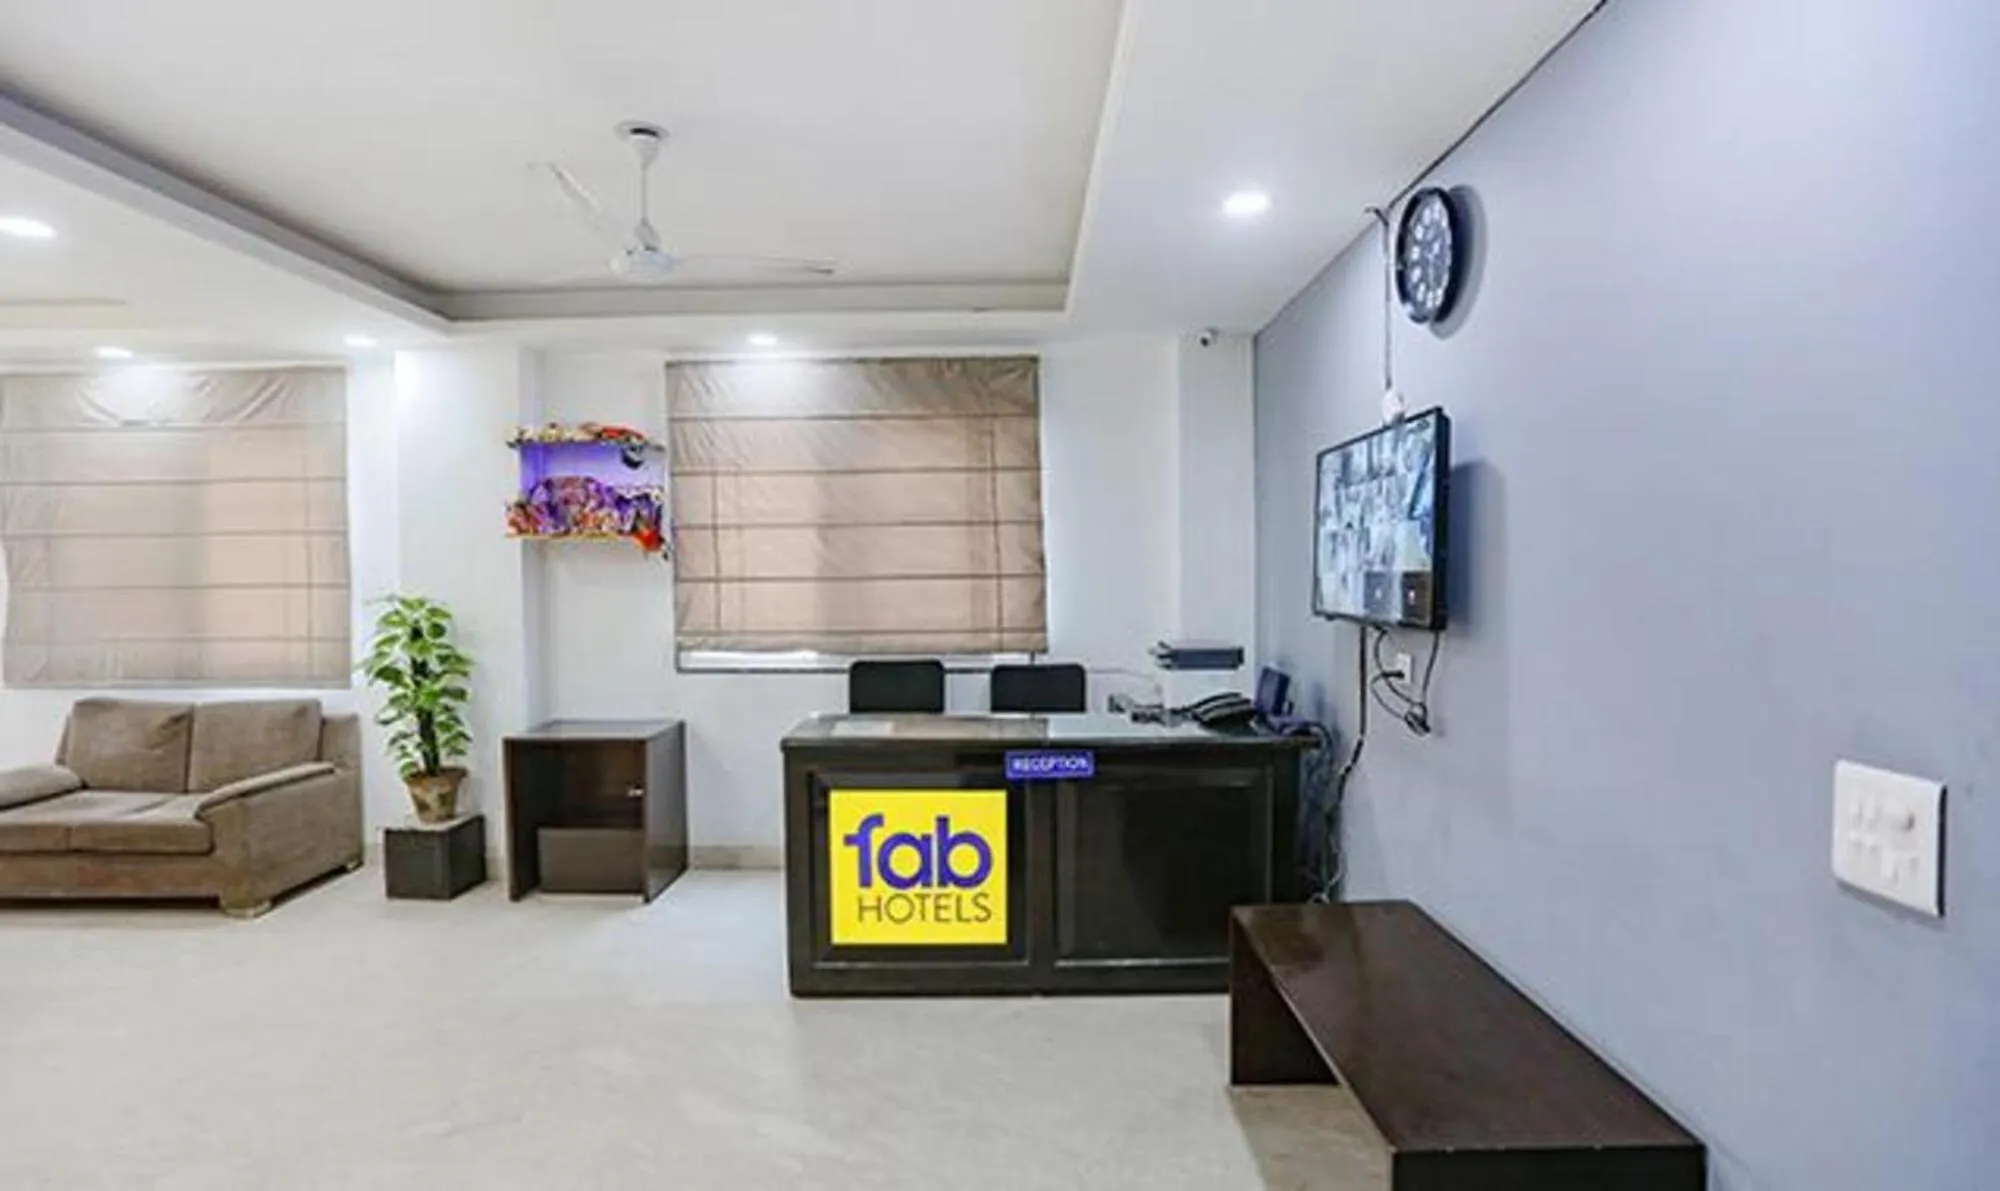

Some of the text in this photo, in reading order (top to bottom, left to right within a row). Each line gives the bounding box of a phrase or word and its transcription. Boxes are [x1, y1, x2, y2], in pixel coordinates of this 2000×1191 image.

[1012, 756, 1088, 772] RECEPTION
[843, 813, 993, 890] fab
[857, 892, 993, 924] HOTELS
